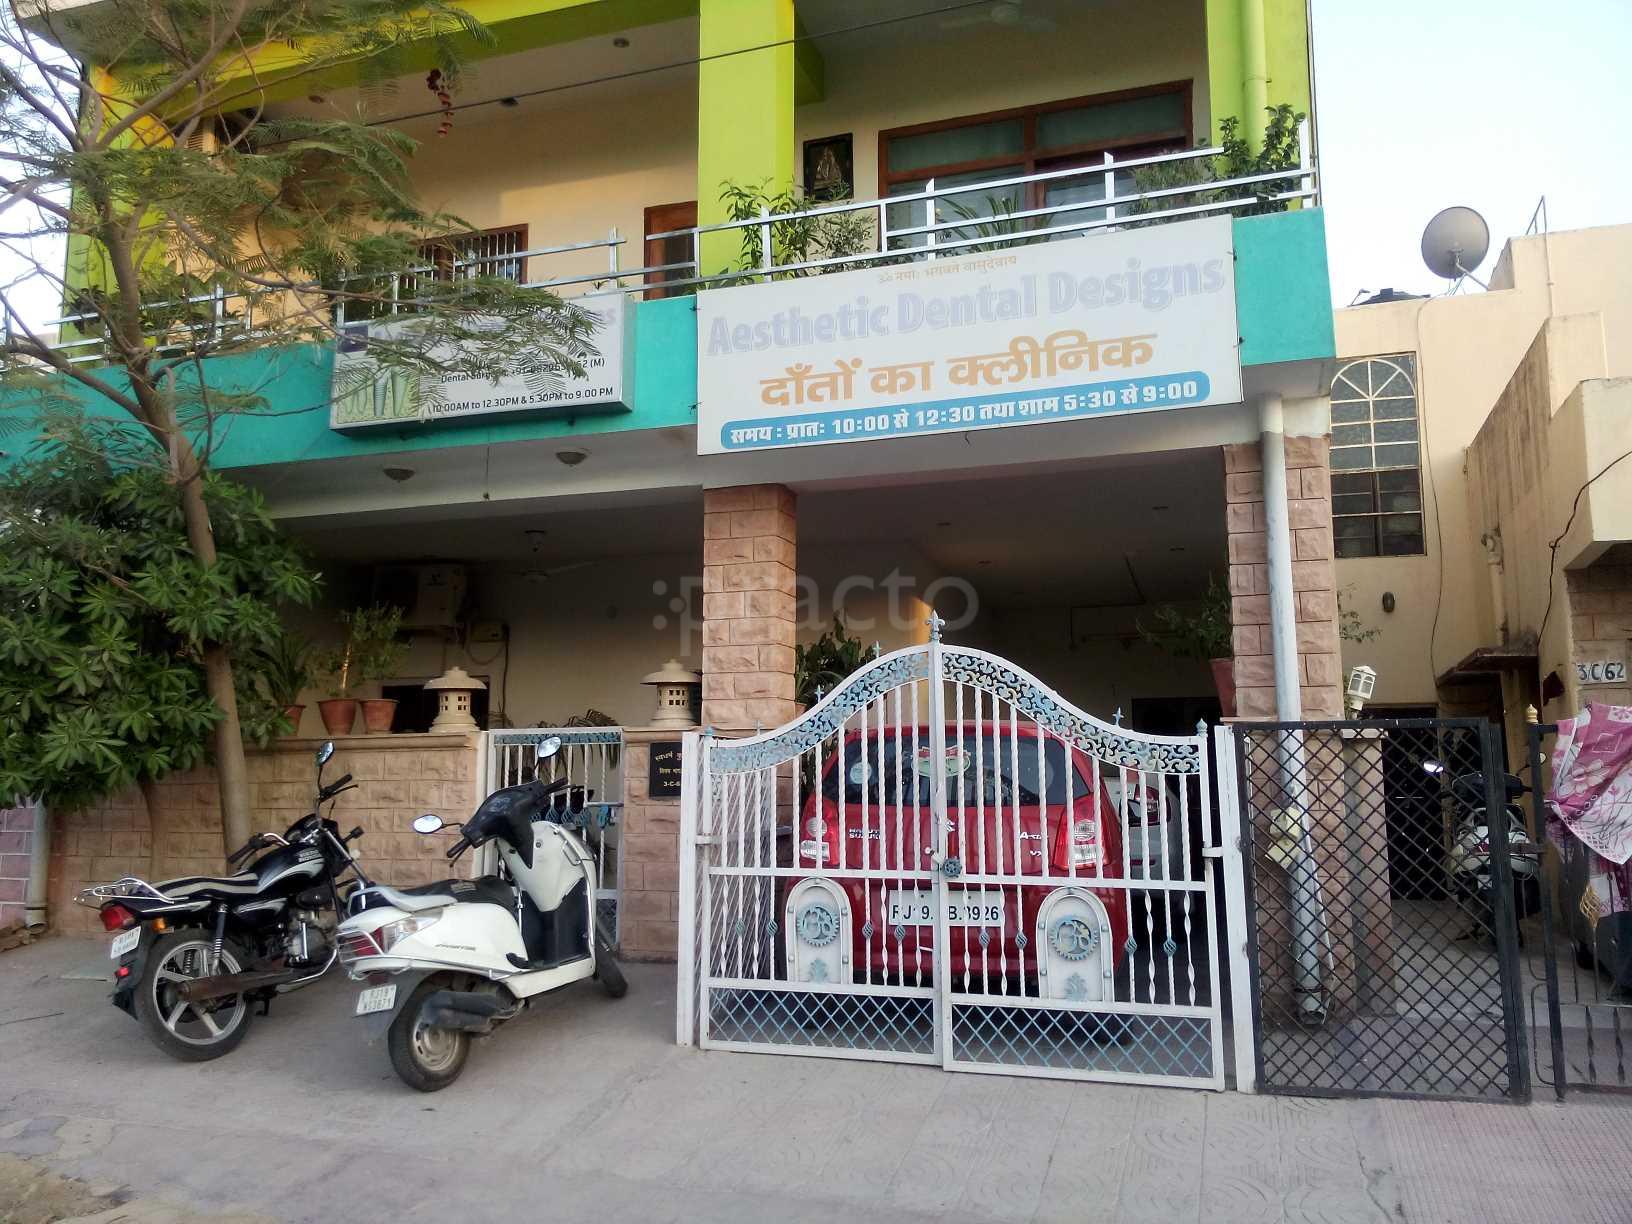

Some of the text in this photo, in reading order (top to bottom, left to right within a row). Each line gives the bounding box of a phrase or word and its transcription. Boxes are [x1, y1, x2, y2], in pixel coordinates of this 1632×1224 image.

[706, 257, 1226, 357] Aesthetic Dental Designs
[590, 358, 605, 369] (M)
[760, 329, 1158, 407] दाँतों का क्लीनिक
[472, 401, 481, 409] to
[521, 396, 527, 405] &
[529, 391, 562, 404] 5.30PM
[564, 392, 574, 400] to
[576, 389, 598, 399] 9.00
[600, 387, 613, 397] PM
[730, 426, 773, 444] समय
[832, 413, 889, 435] 10:00
[893, 408, 910, 429] से
[915, 403, 975, 427] 12:30
[979, 401, 1016, 420] तथा
[1018, 396, 1061, 416] शाम
[1063, 389, 1116, 411] 5:30
[1120, 383, 1140, 405] से
[1143, 380, 1198, 401] 9:00
[1577, 662, 1625, 681] 3/C/62
